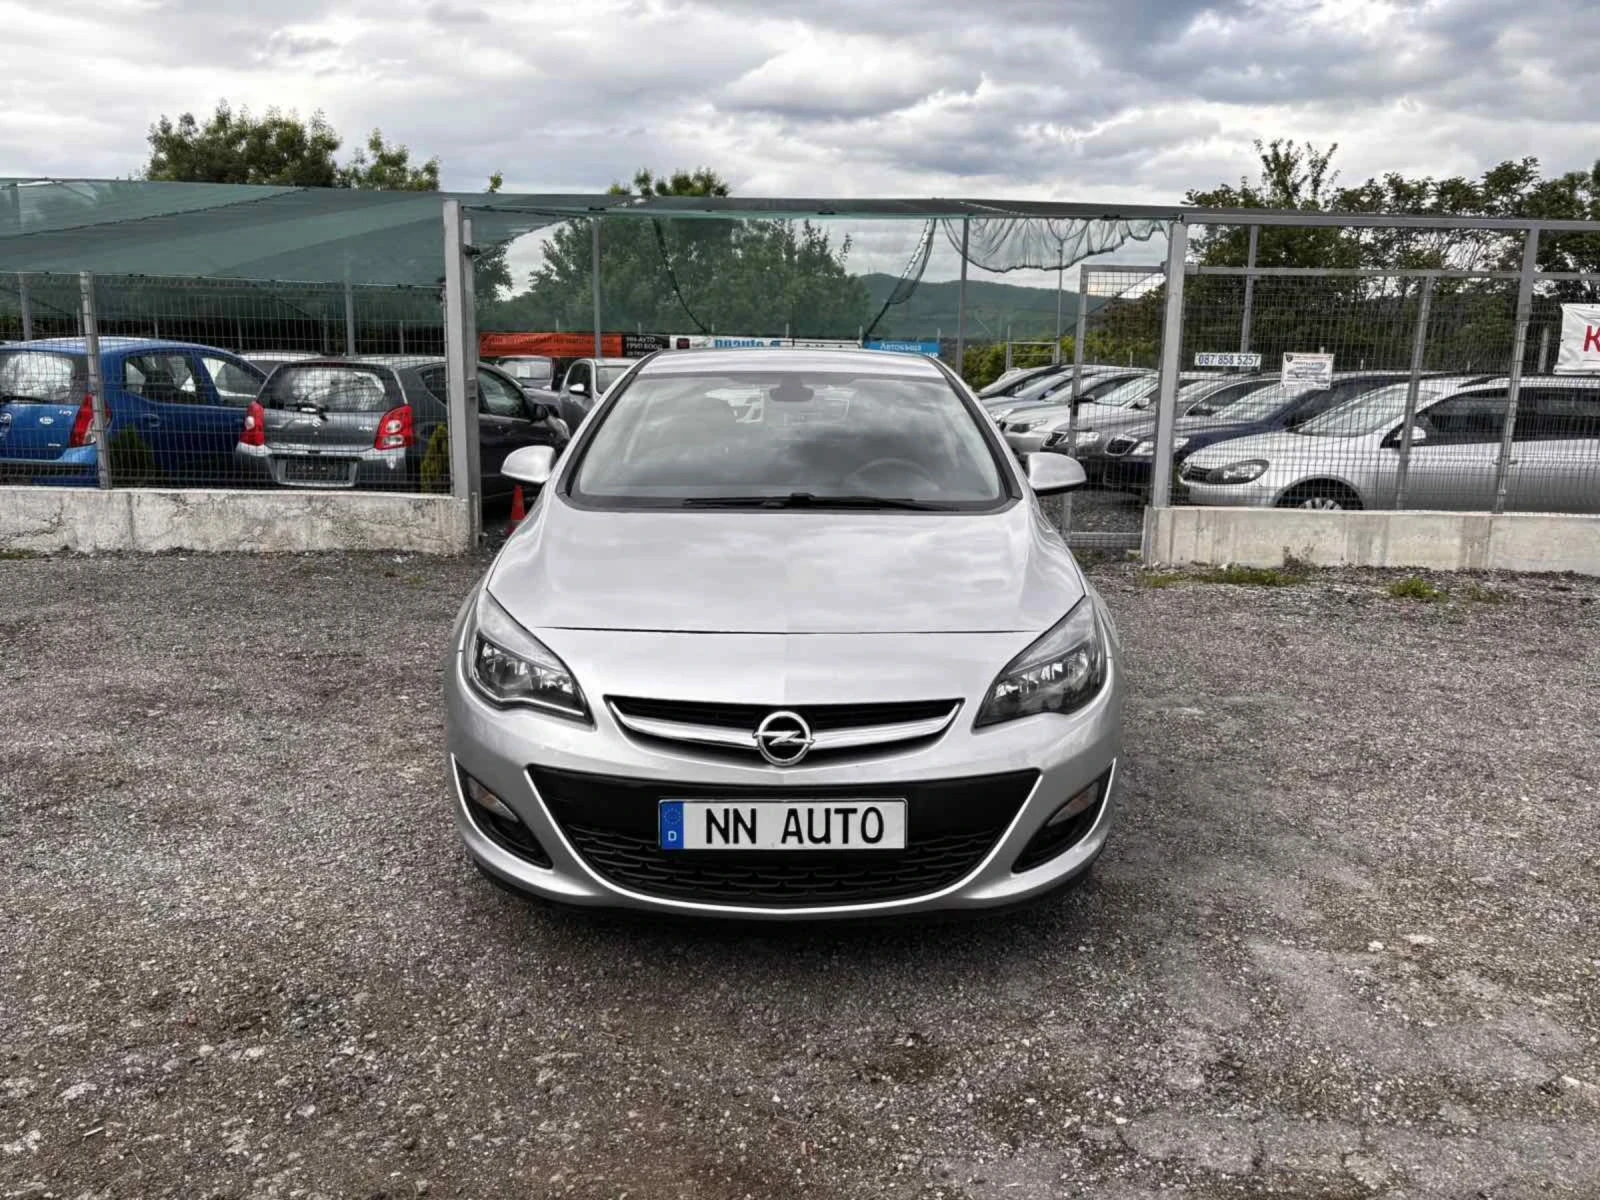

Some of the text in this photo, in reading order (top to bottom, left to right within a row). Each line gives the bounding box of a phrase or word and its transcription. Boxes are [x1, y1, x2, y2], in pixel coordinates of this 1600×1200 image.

[668, 831, 677, 842] D
[706, 807, 885, 845] NN AUTO
